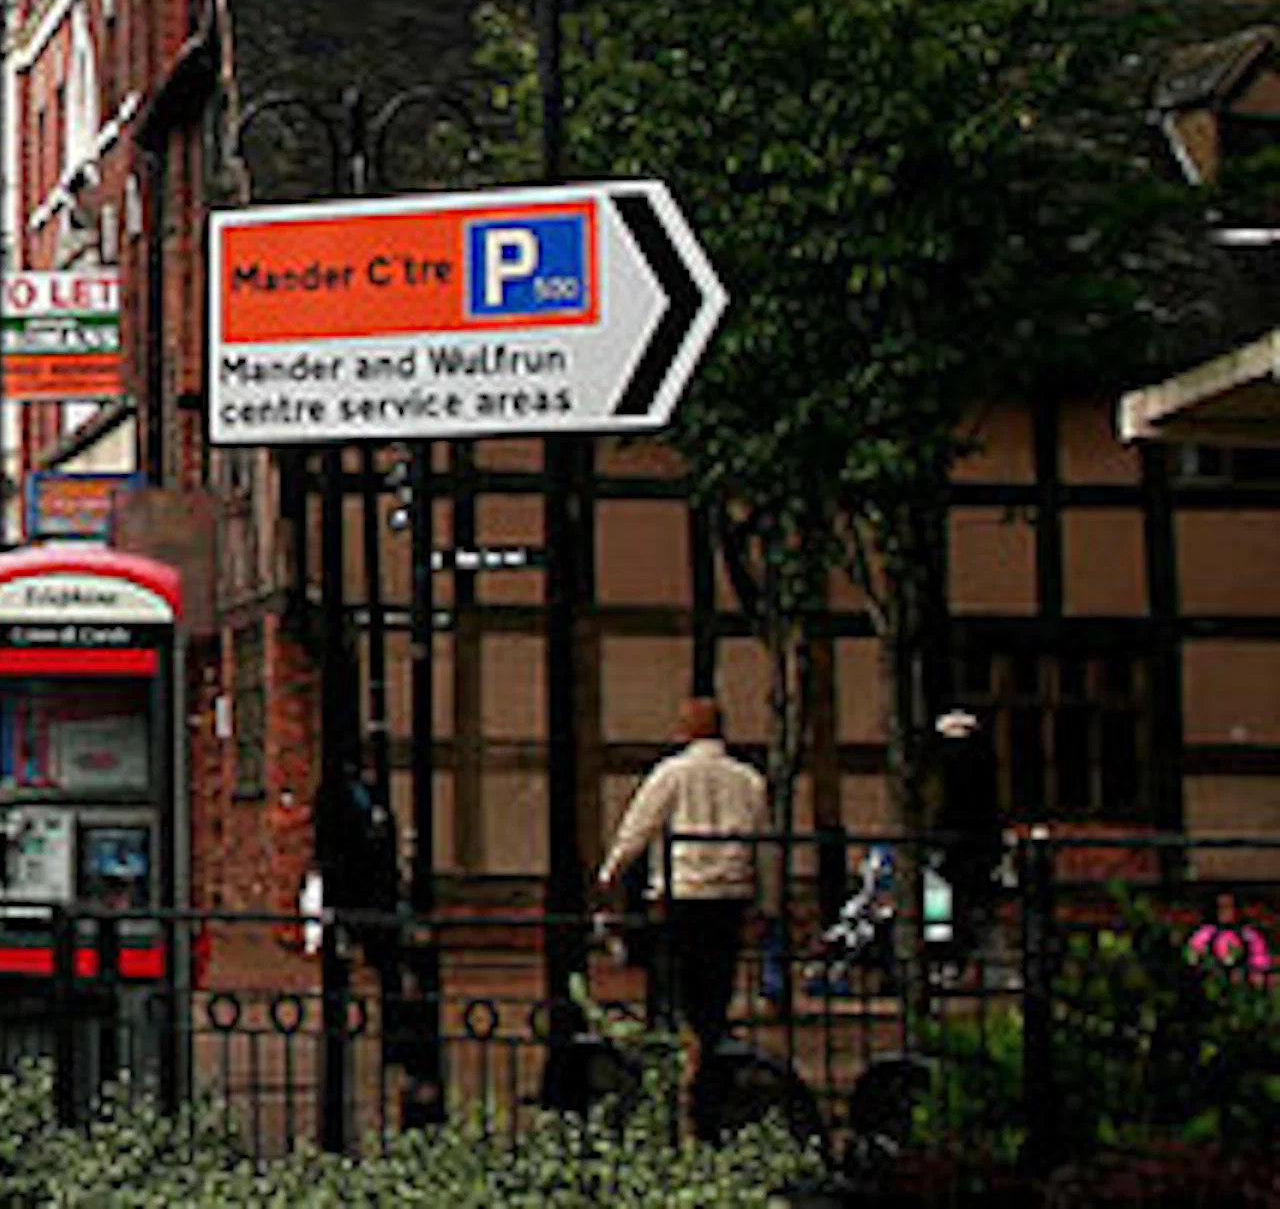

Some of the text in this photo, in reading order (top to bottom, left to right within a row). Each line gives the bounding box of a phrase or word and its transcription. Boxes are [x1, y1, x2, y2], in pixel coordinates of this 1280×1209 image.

[233, 259, 352, 290] Mander
[484, 228, 539, 306] P
[221, 345, 566, 383] Mander and Wulfrun
[220, 388, 572, 424] centre service areas
